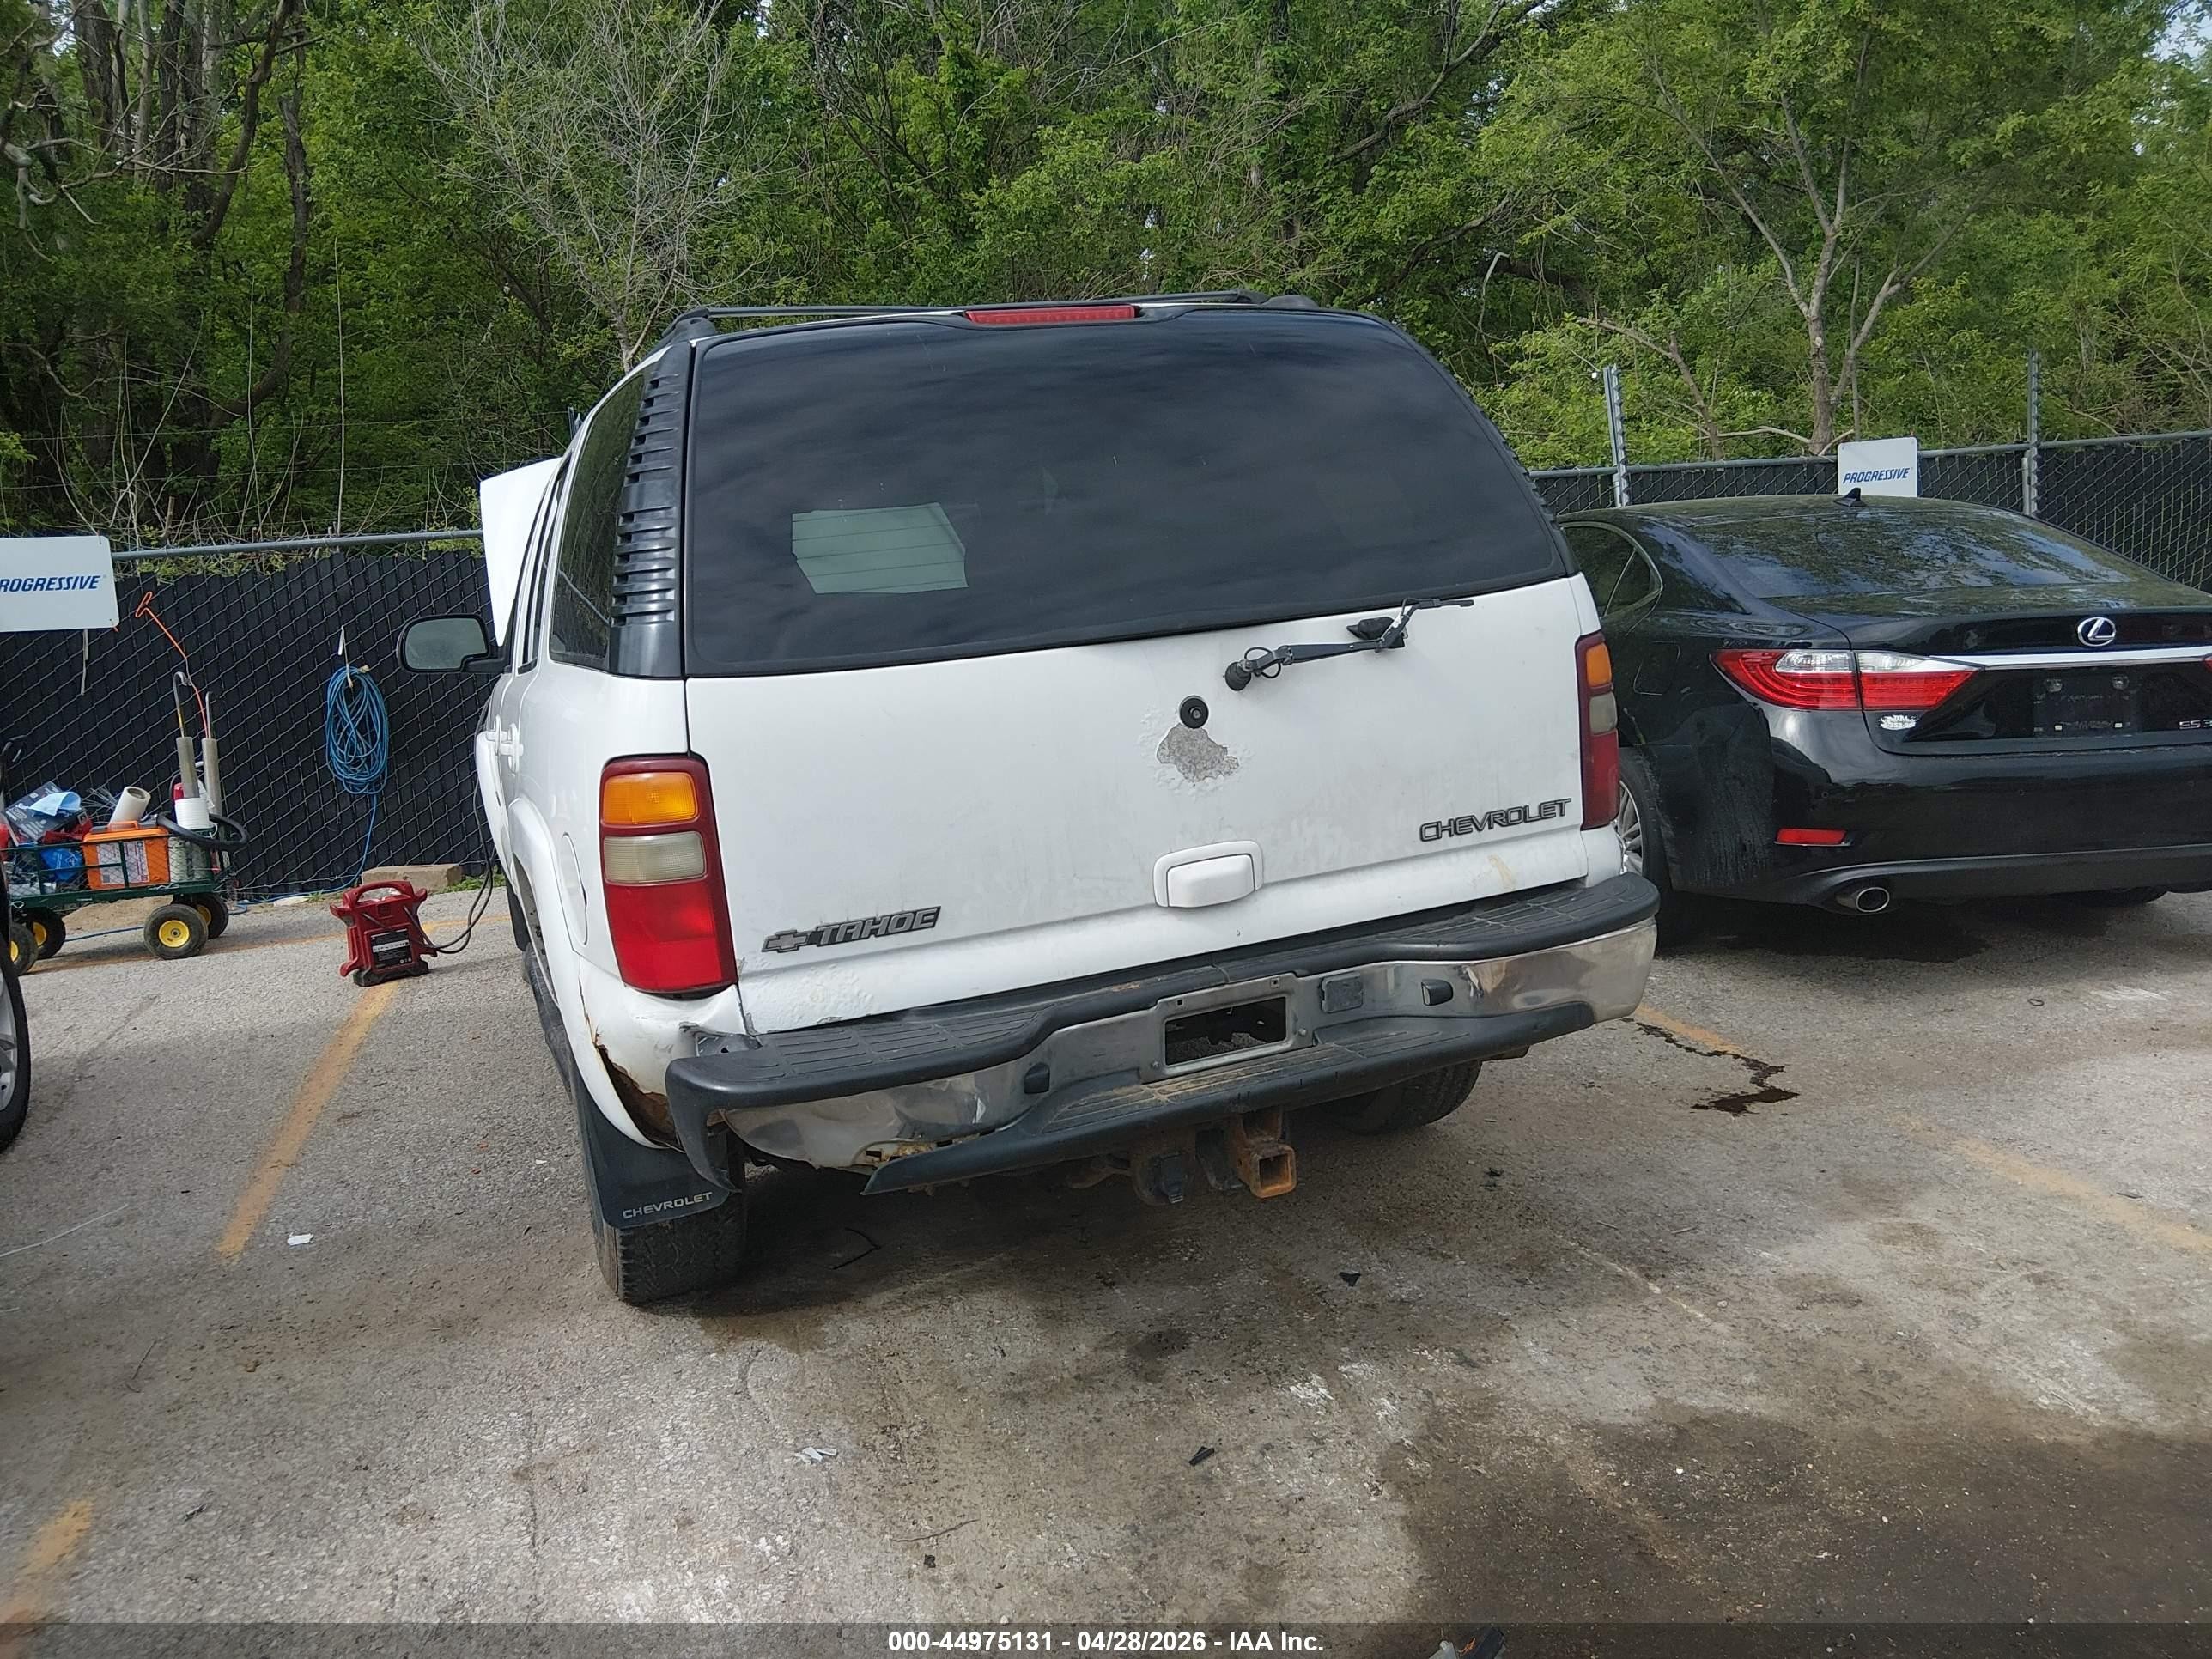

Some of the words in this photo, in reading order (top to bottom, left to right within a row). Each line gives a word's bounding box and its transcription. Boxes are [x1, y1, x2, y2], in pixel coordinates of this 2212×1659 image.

[1843, 467, 1911, 484] PROGRESSIVE
[1419, 798, 1572, 842] CHEVROLET
[817, 906, 941, 947] TAHOE
[623, 1192, 713, 1219] CHEVROLET
